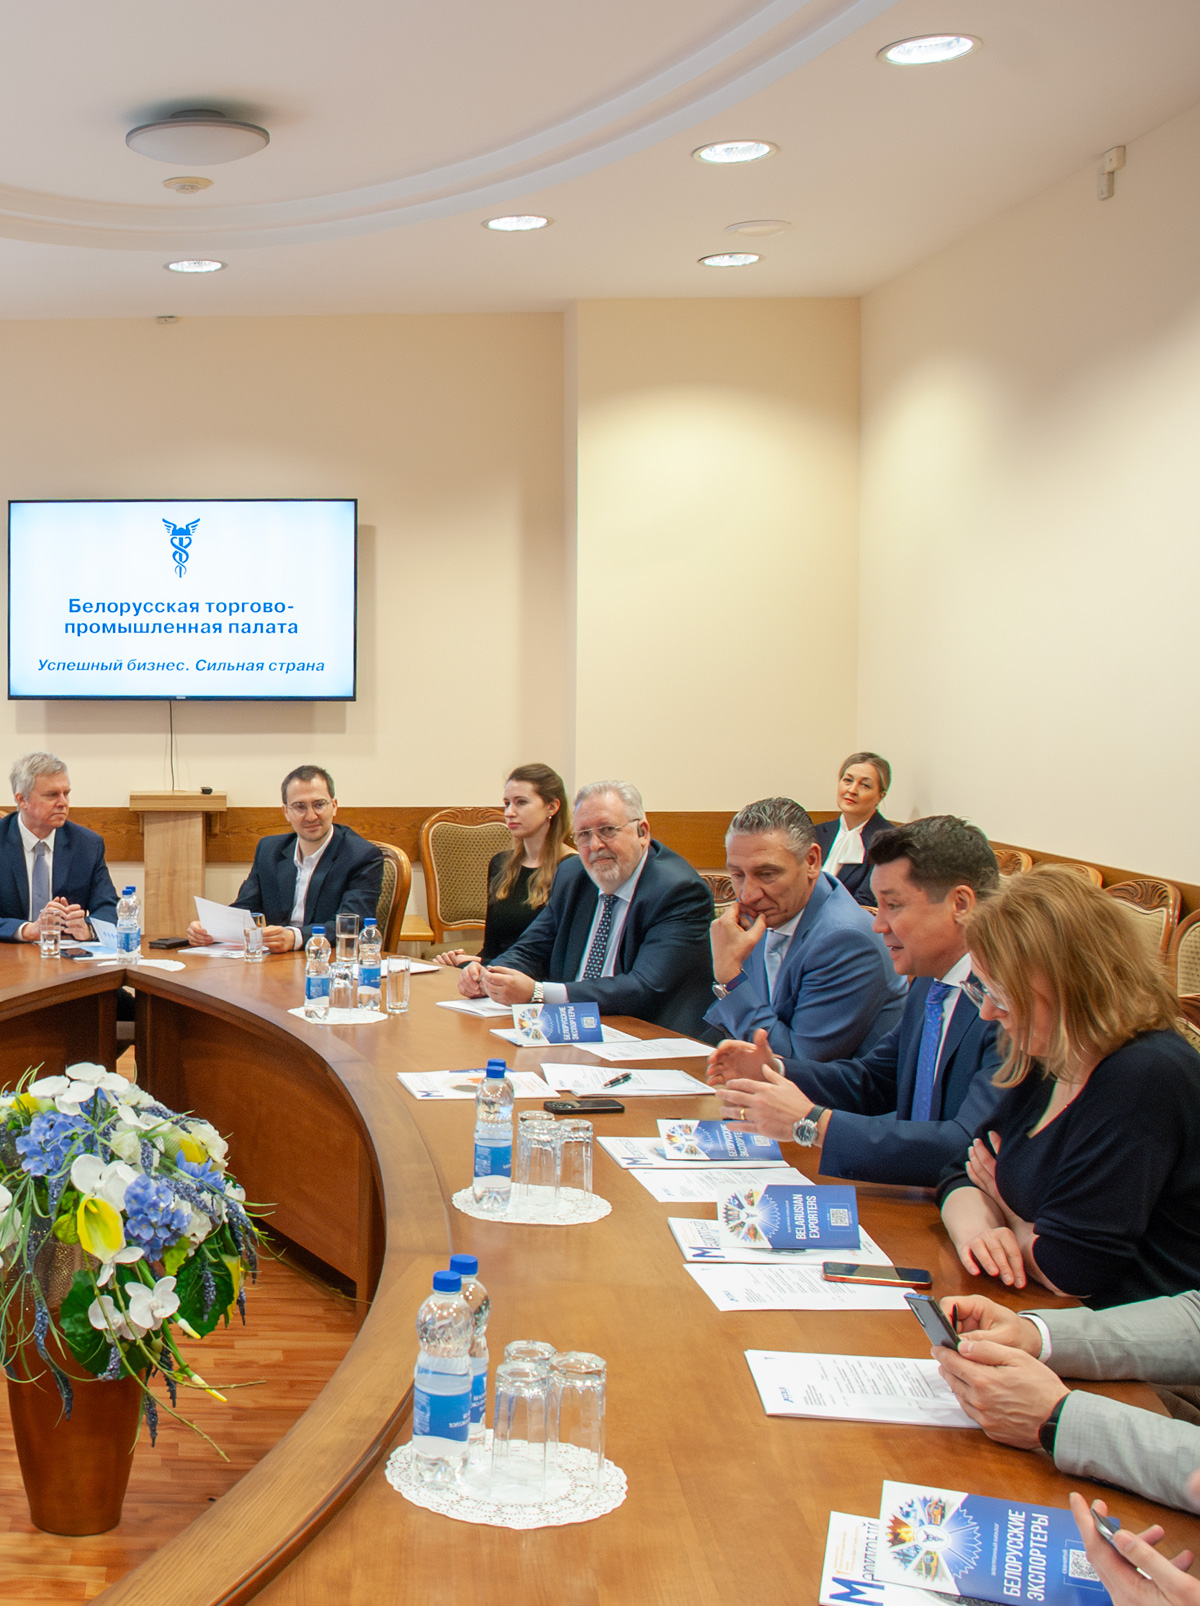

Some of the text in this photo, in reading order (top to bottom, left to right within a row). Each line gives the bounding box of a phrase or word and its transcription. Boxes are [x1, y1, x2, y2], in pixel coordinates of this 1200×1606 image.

[69, 599, 293, 616] Белорусская торгово-
[65, 623, 298, 637] промышленная палата
[38, 659, 325, 672] Успешный бизнес. Сильная страна
[792, 1193, 807, 1239] BELARUSIAN
[805, 1195, 820, 1238] EXPORTERS
[1003, 1509, 1026, 1597] БЕЛОРУССКИЕ
[1027, 1513, 1049, 1602] ЭКСПОРТЕРЫ
